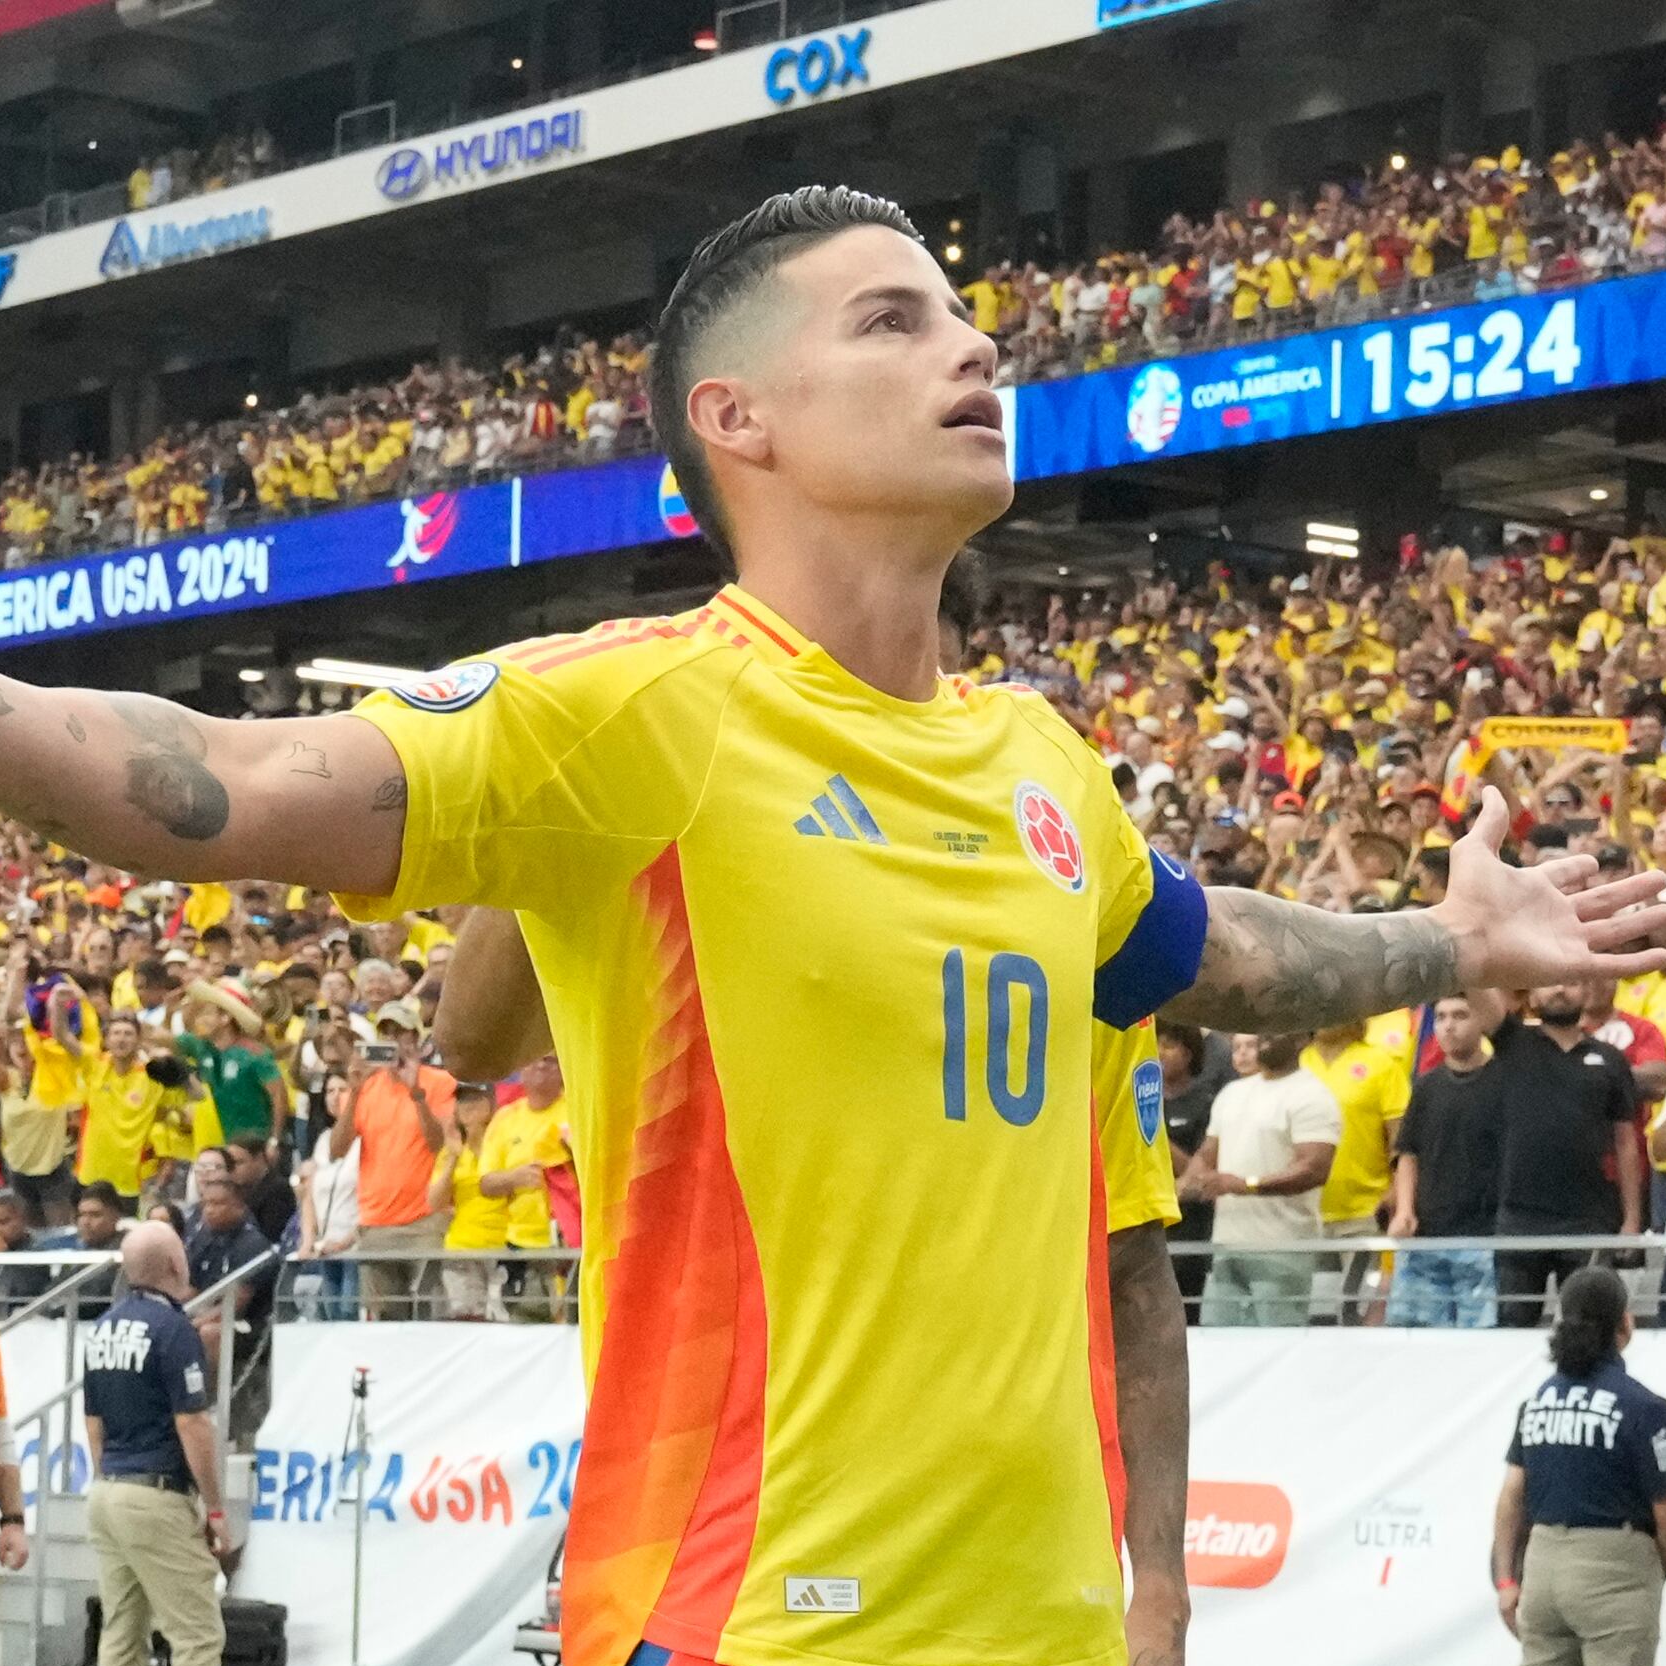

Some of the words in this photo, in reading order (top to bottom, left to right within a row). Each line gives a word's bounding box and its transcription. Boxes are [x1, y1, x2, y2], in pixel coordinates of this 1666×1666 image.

[764, 27, 871, 105] COX
[434, 110, 581, 178] HYUNDAI
[1363, 298, 1582, 414] 15:24
[100, 556, 171, 618] USA
[177, 537, 269, 605] 2024
[941, 948, 1049, 1127] 10
[410, 1453, 513, 1528] USA
[1354, 1520, 1433, 1548] ULTRA
